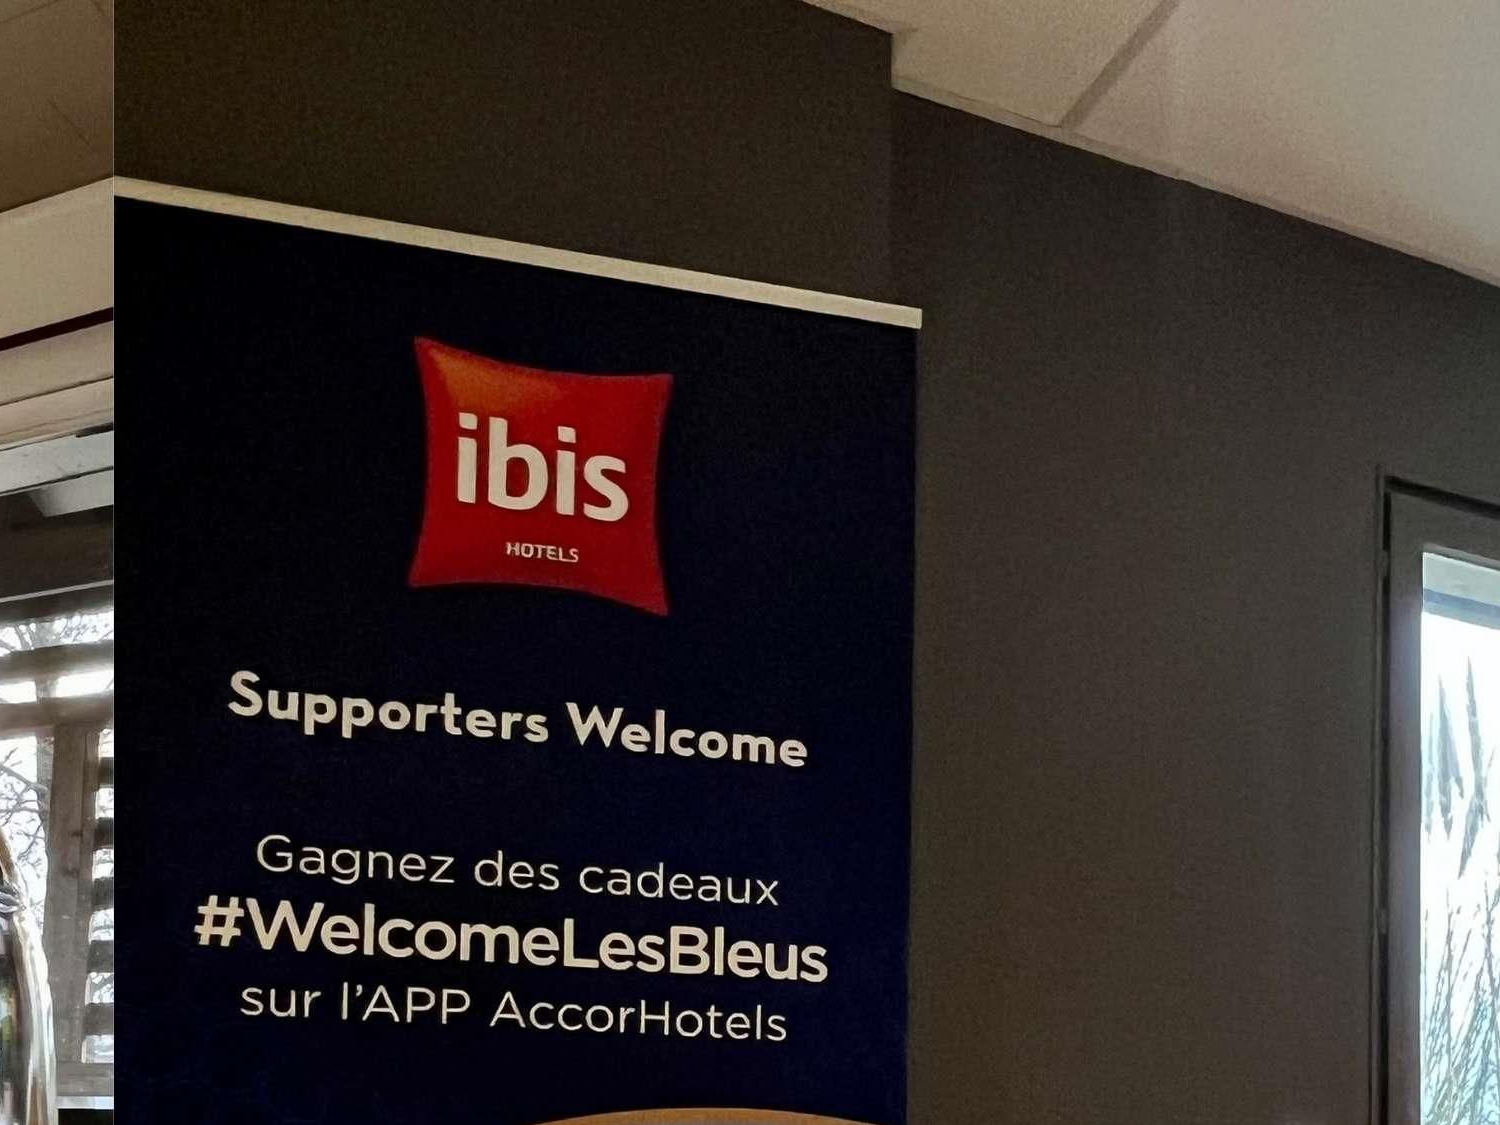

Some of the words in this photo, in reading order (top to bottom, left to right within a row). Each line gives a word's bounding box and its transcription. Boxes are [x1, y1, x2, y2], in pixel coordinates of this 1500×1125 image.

[457, 411, 630, 522] ibis
[505, 541, 580, 563] HOTELS
[227, 669, 549, 743] Supporters
[564, 701, 809, 768] Welcome
[256, 834, 456, 885] Gagnez
[474, 849, 560, 891] des
[579, 862, 780, 906] cadeaux
[193, 894, 829, 983] #WelcomeLesBleus
[240, 986, 322, 1018] sur
[489, 990, 788, 1041] AccorHotels
